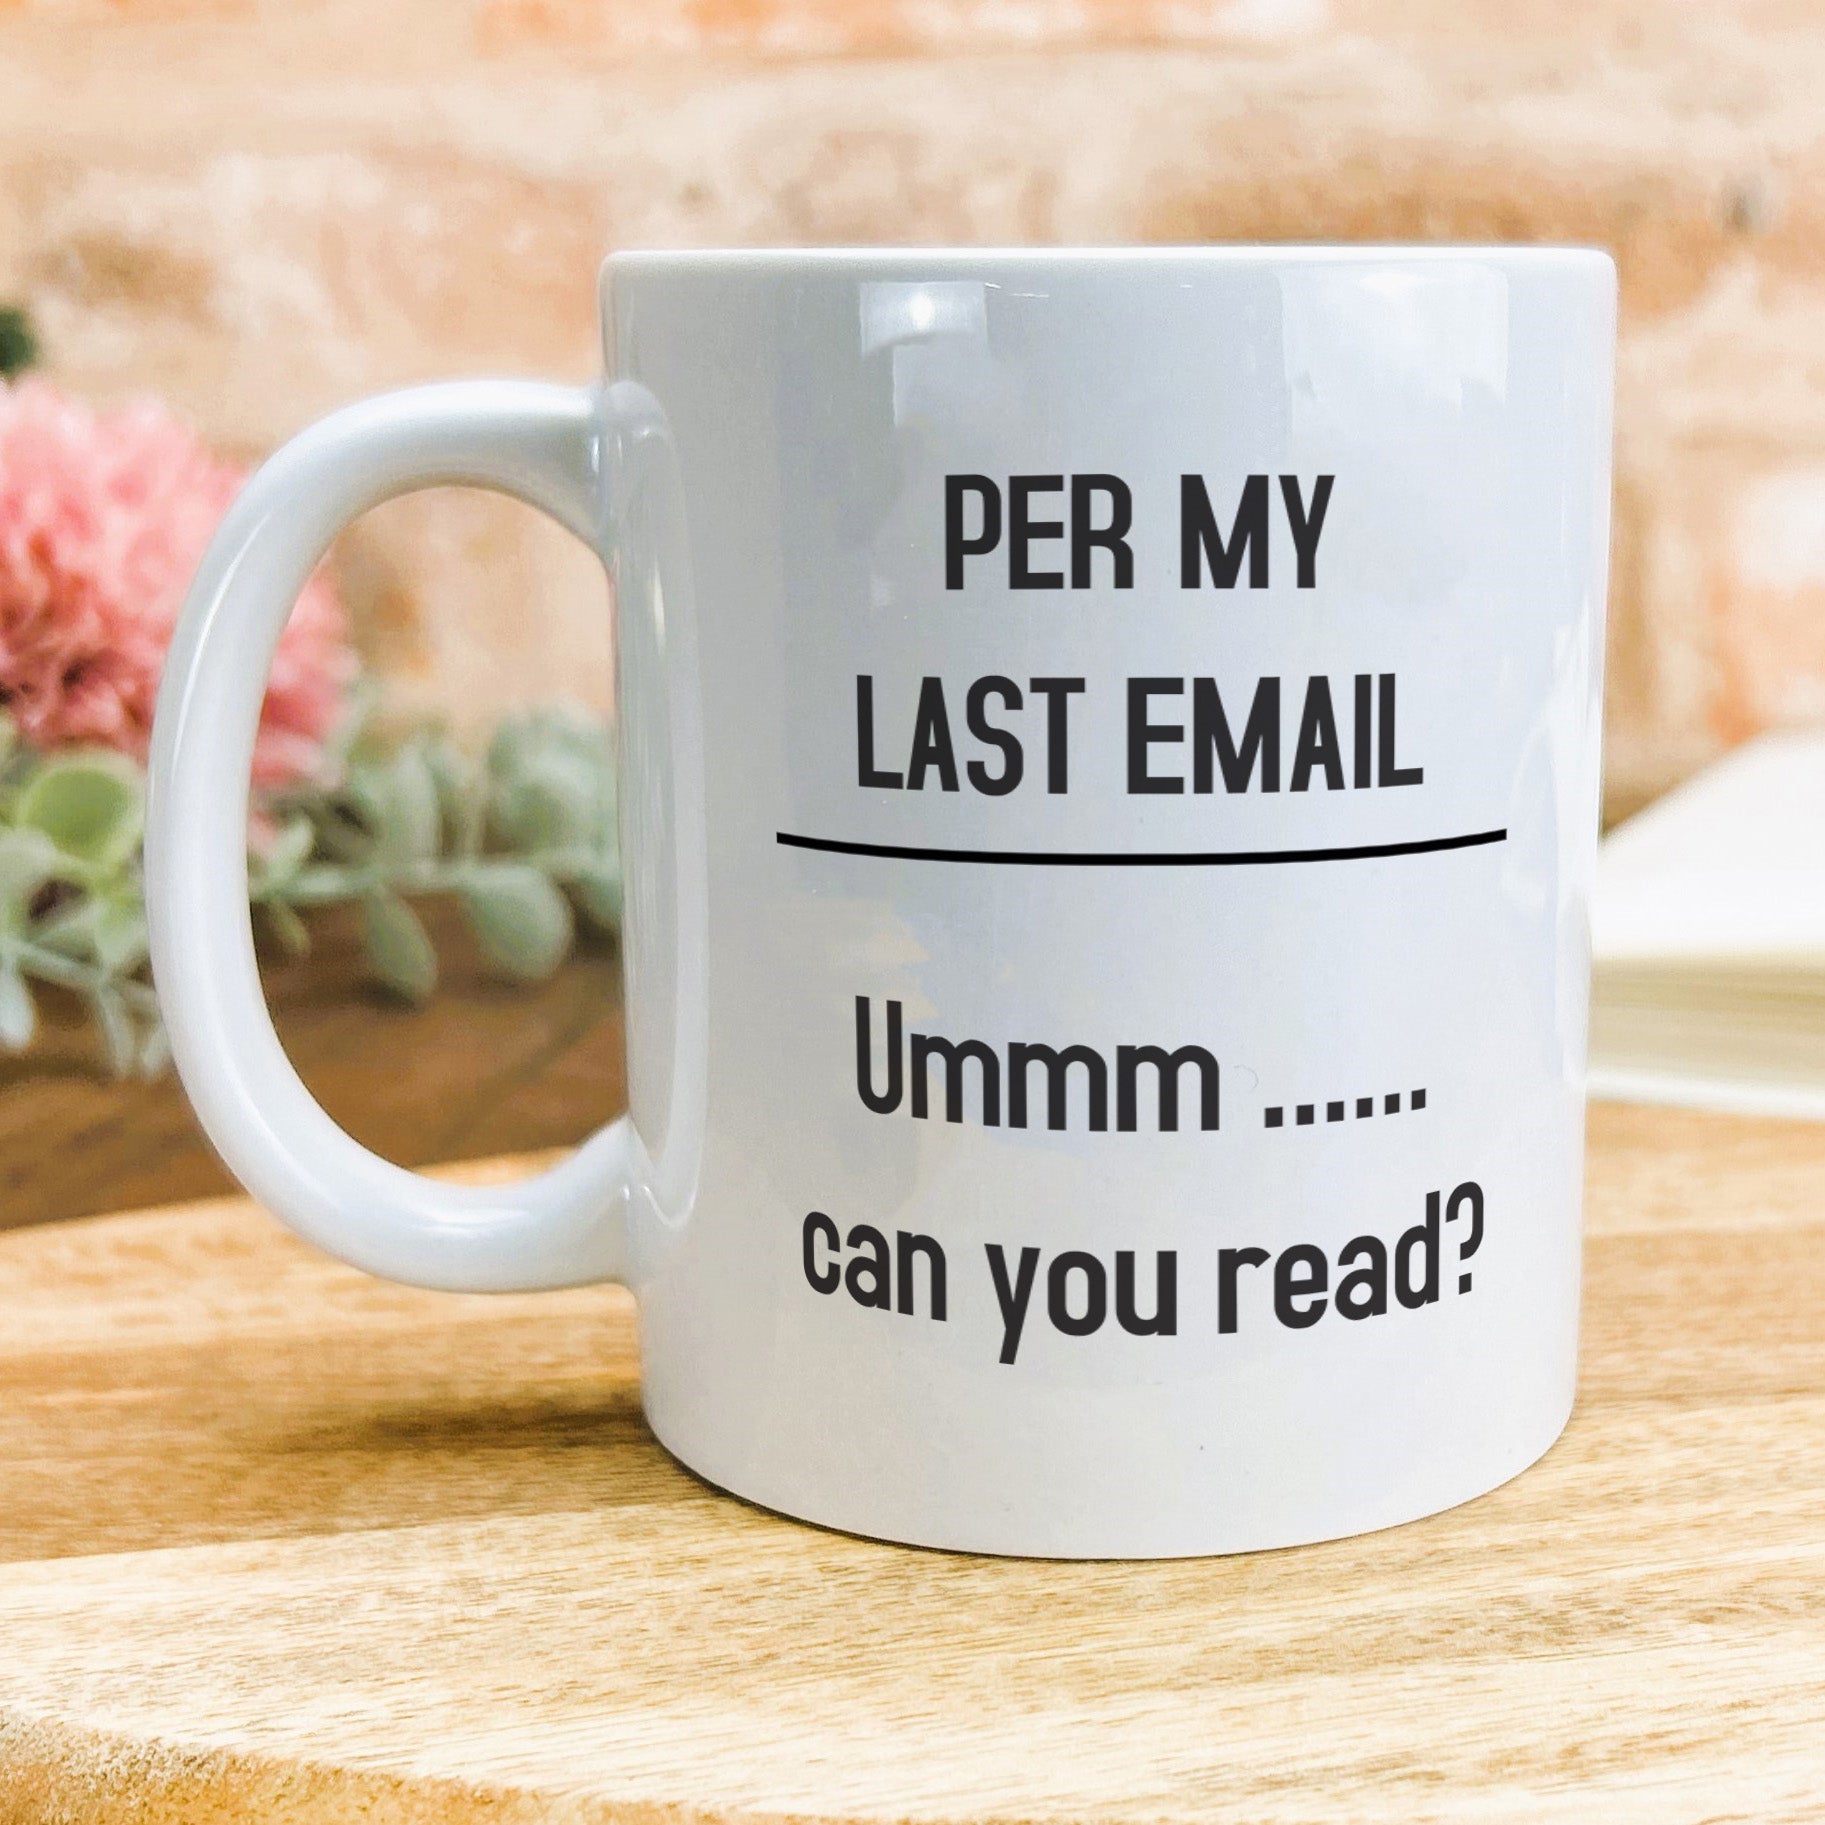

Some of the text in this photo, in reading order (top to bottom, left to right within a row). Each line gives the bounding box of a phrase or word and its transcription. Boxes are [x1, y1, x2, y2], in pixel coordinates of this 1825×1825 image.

[945, 473, 1335, 591] PER MY
[856, 673, 1424, 797] LAST EMAIL
[855, 995, 1220, 1132] Ummm
[802, 1181, 1485, 1365] can you read?
